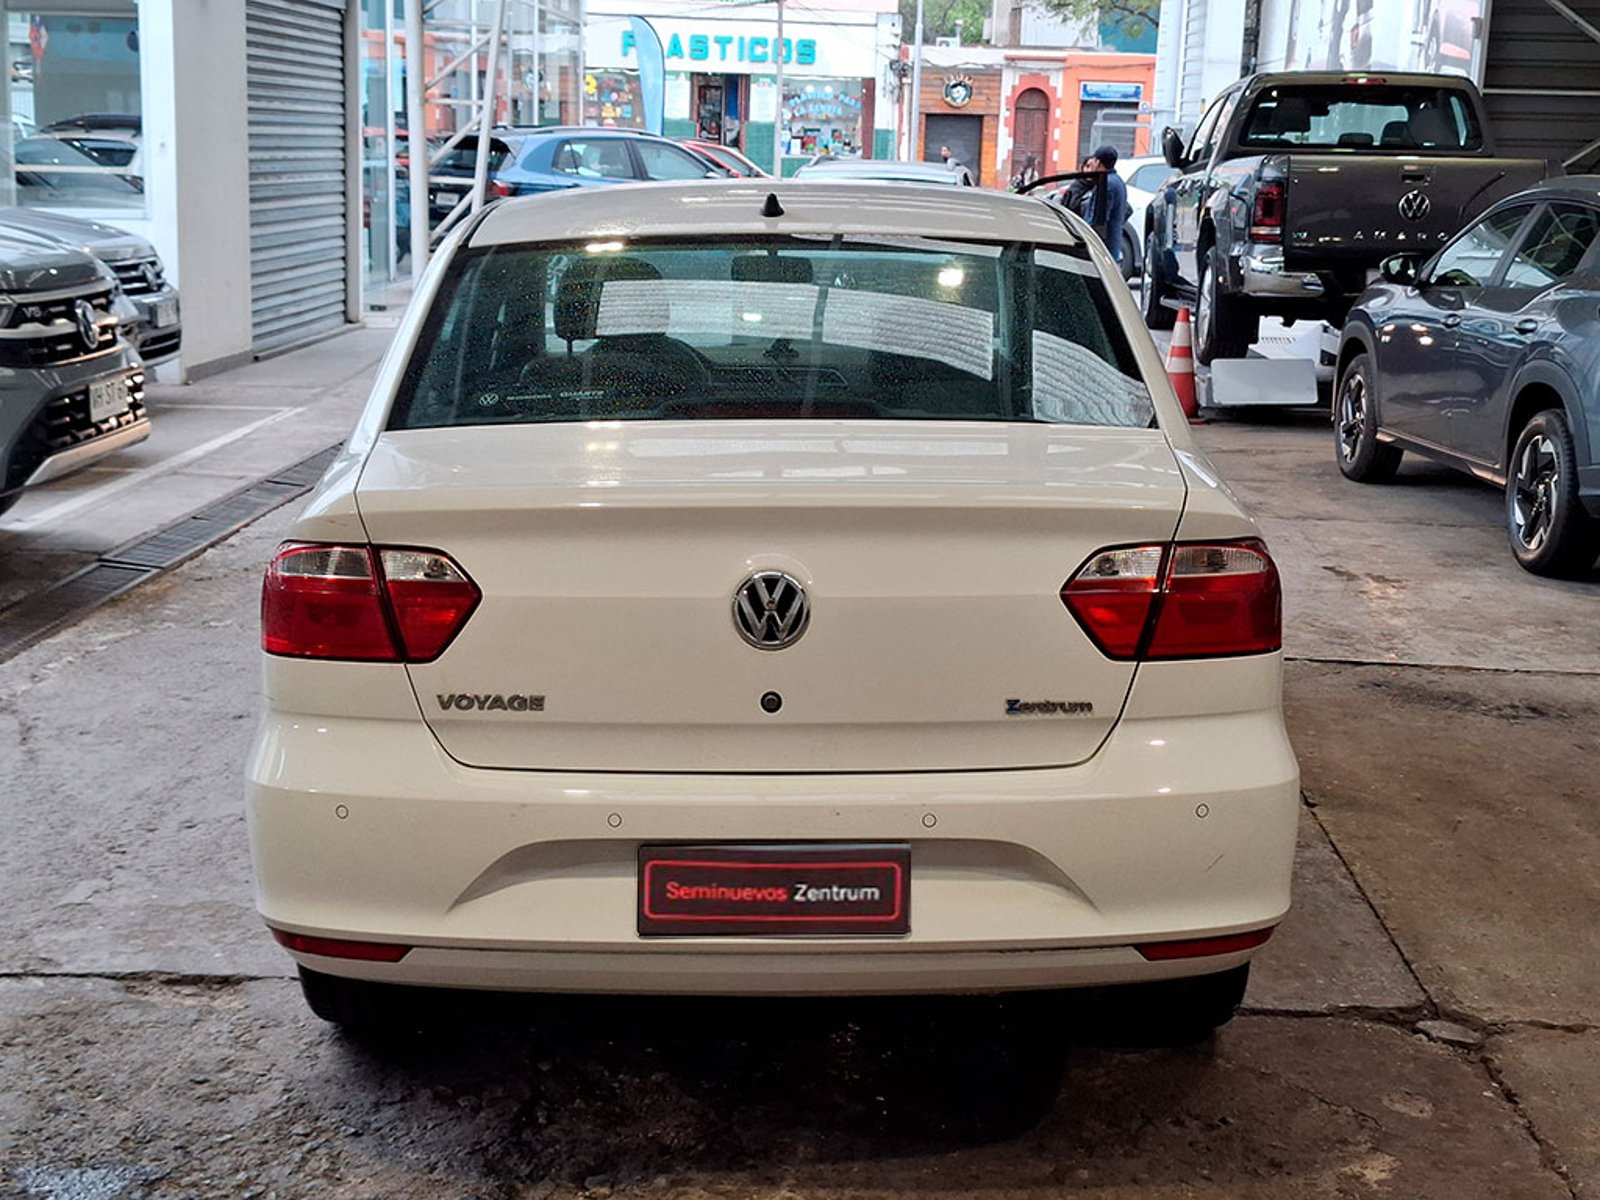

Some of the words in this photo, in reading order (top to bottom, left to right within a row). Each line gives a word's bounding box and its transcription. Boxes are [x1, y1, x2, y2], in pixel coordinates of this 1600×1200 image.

[621, 30, 816, 65] PASTICOS
[436, 694, 545, 711] VOYAGE
[1006, 699, 1093, 714] Zentrum
[666, 881, 787, 901] Seminuevos
[793, 884, 880, 902] Zentrum
